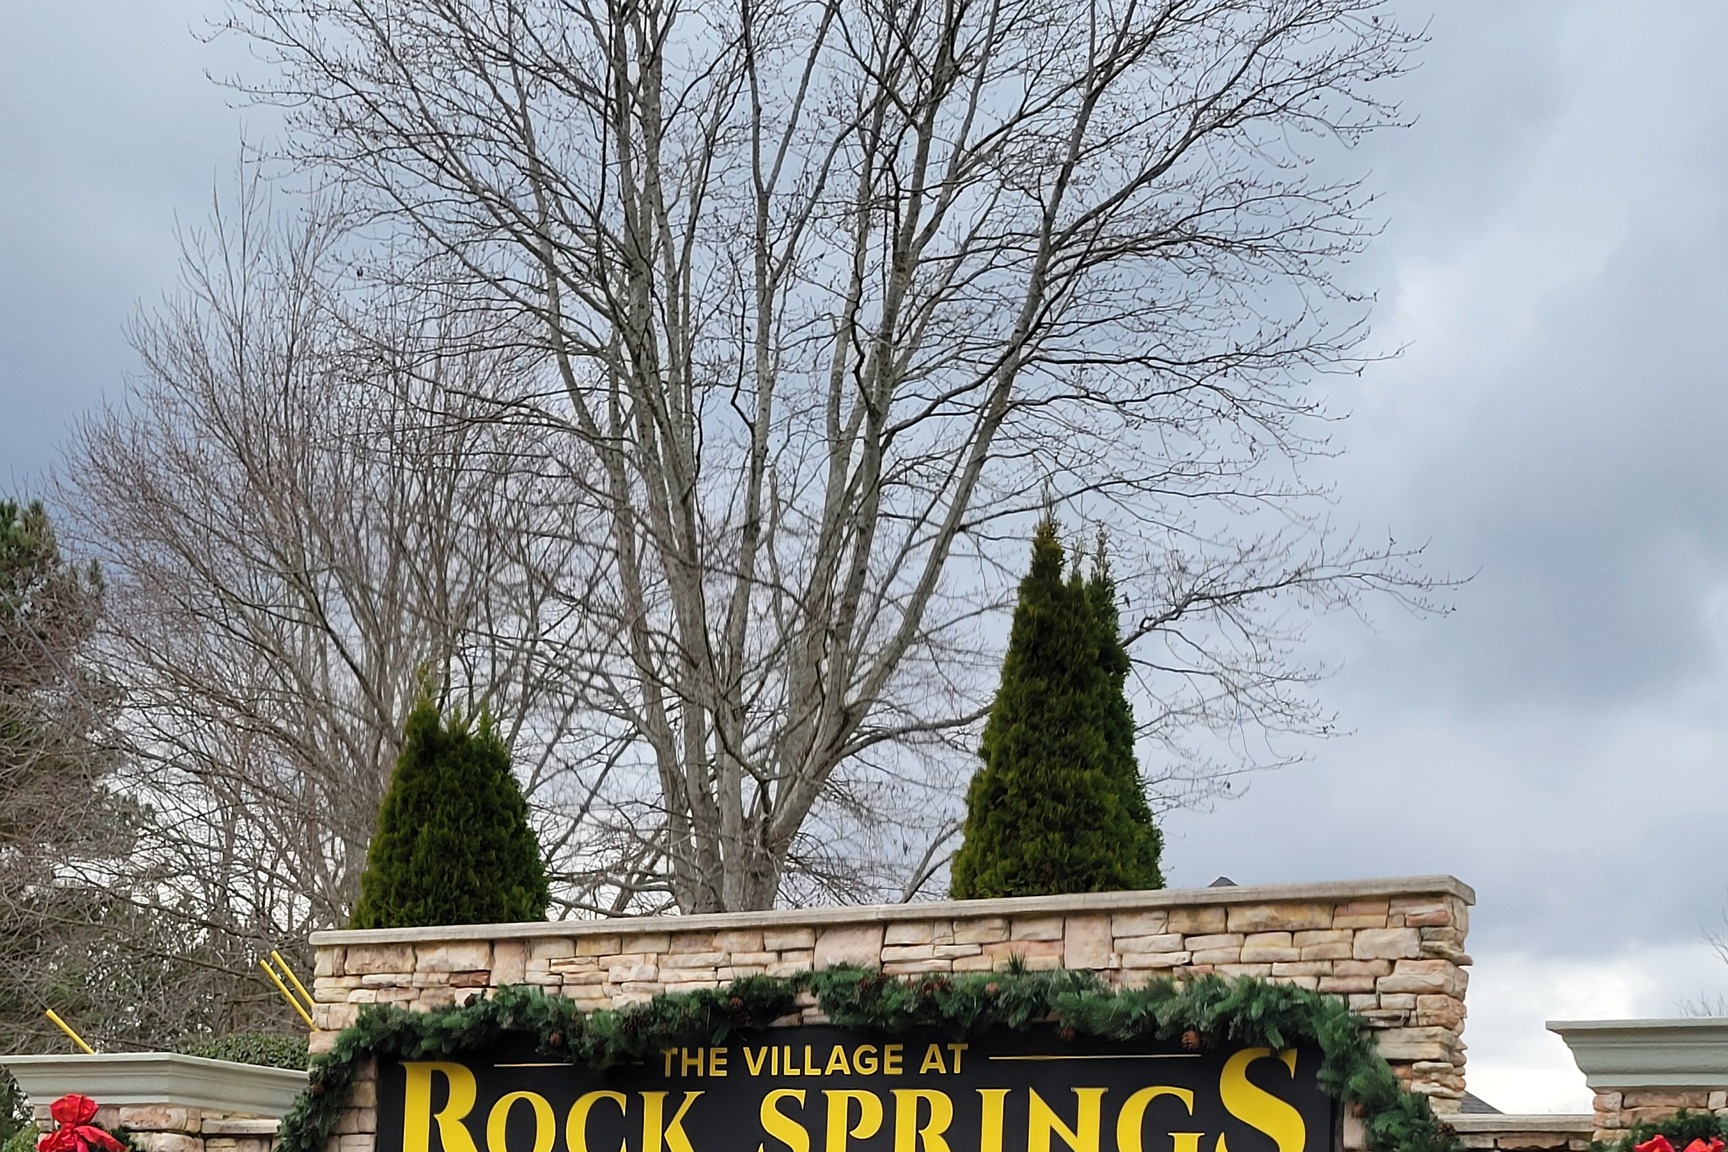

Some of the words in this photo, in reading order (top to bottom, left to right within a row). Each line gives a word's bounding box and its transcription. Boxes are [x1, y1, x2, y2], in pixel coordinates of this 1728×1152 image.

[662, 1047, 728, 1077] THE
[743, 1044, 904, 1076] VILLAGE
[918, 1043, 969, 1074] AT
